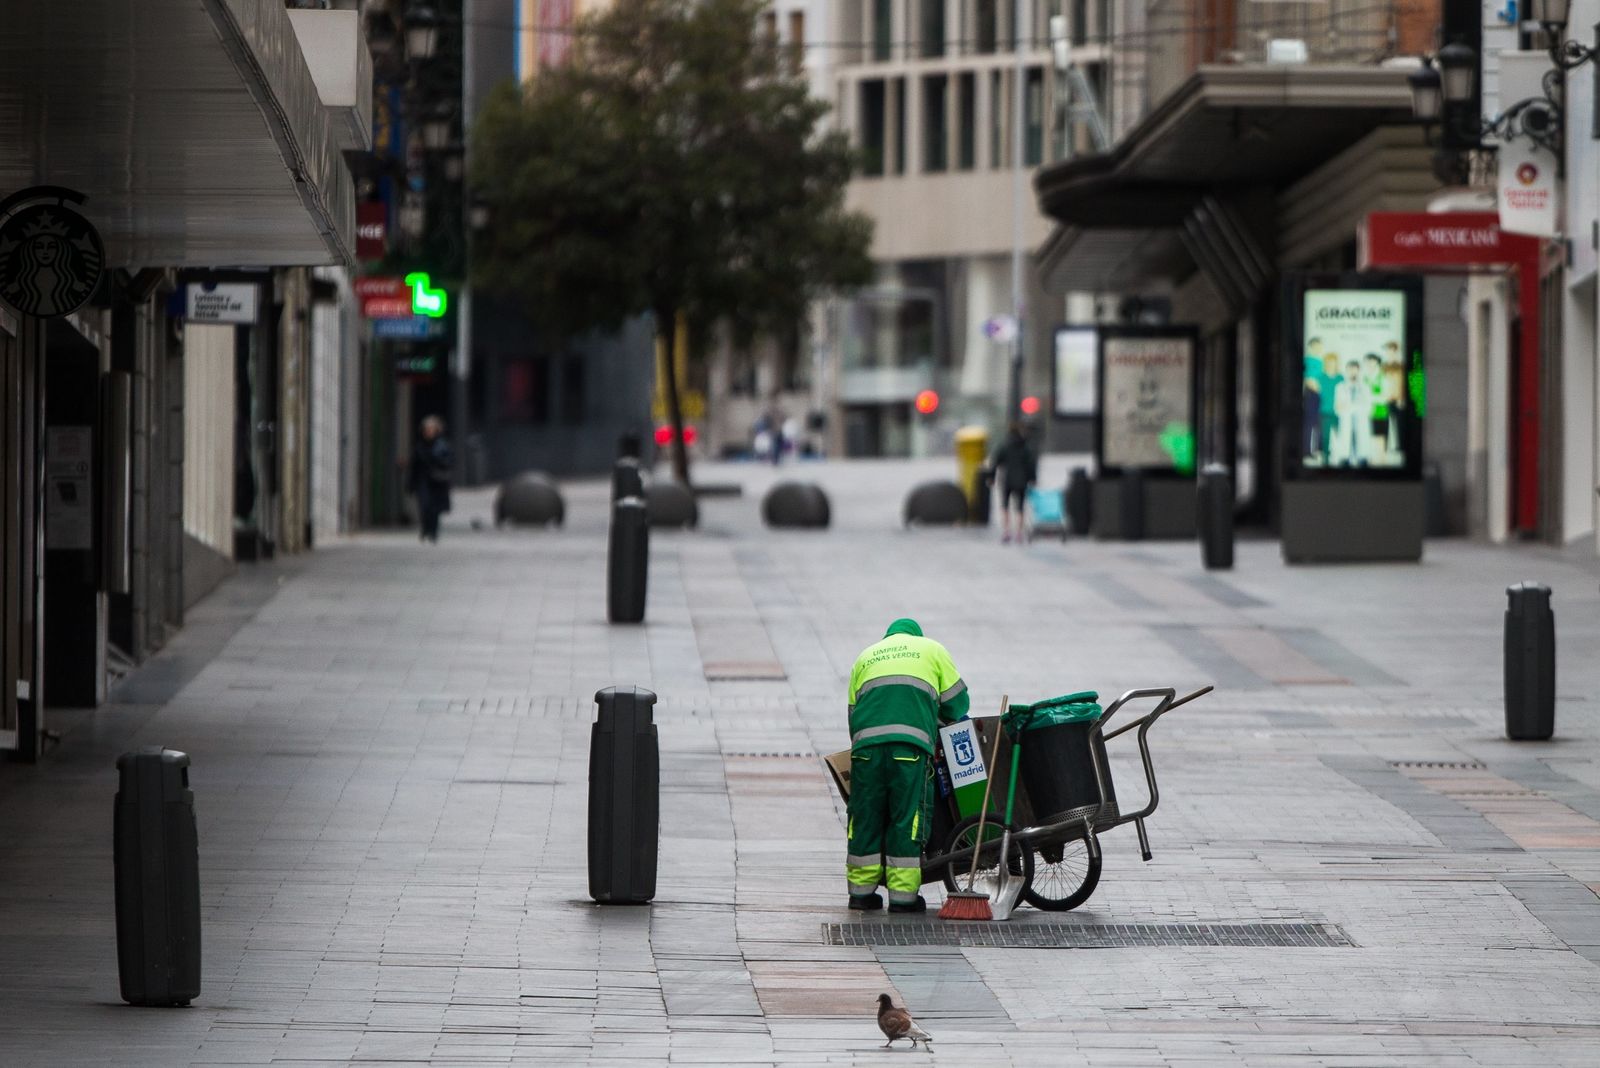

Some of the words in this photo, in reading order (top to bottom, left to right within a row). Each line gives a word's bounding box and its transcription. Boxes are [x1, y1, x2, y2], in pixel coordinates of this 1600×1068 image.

[873, 645, 908, 656] LIMPIEZA
[867, 655, 890, 665] ZONAS
[892, 651, 921, 659] VERDES
[954, 763, 984, 780] madrid
